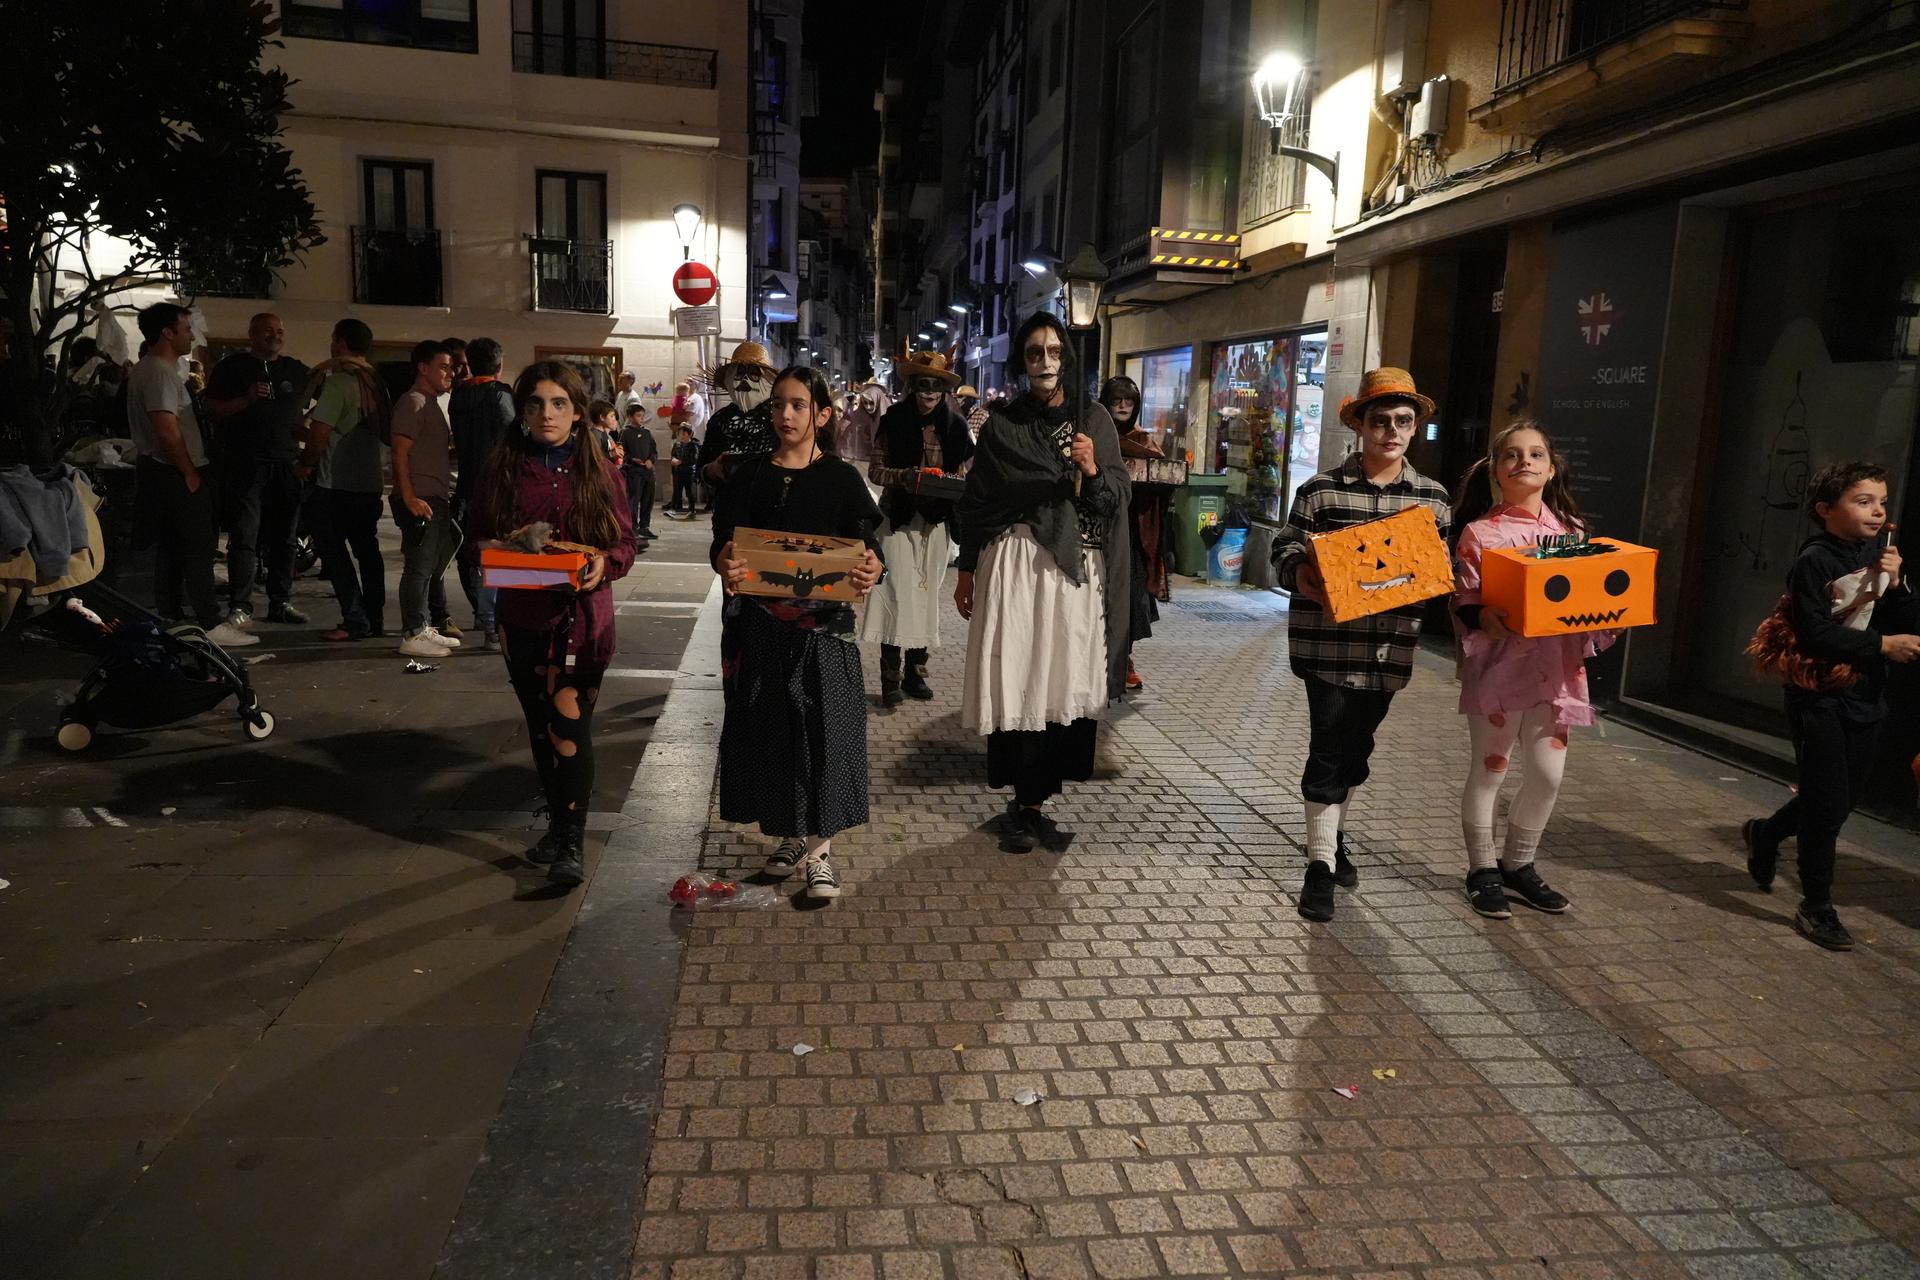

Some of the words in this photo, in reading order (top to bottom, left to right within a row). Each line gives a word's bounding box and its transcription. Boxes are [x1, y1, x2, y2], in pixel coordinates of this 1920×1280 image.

[1552, 400, 1581, 409] SCHOOL
[1583, 400, 1595, 409] OF
[1596, 400, 1631, 409] ENGLISH
